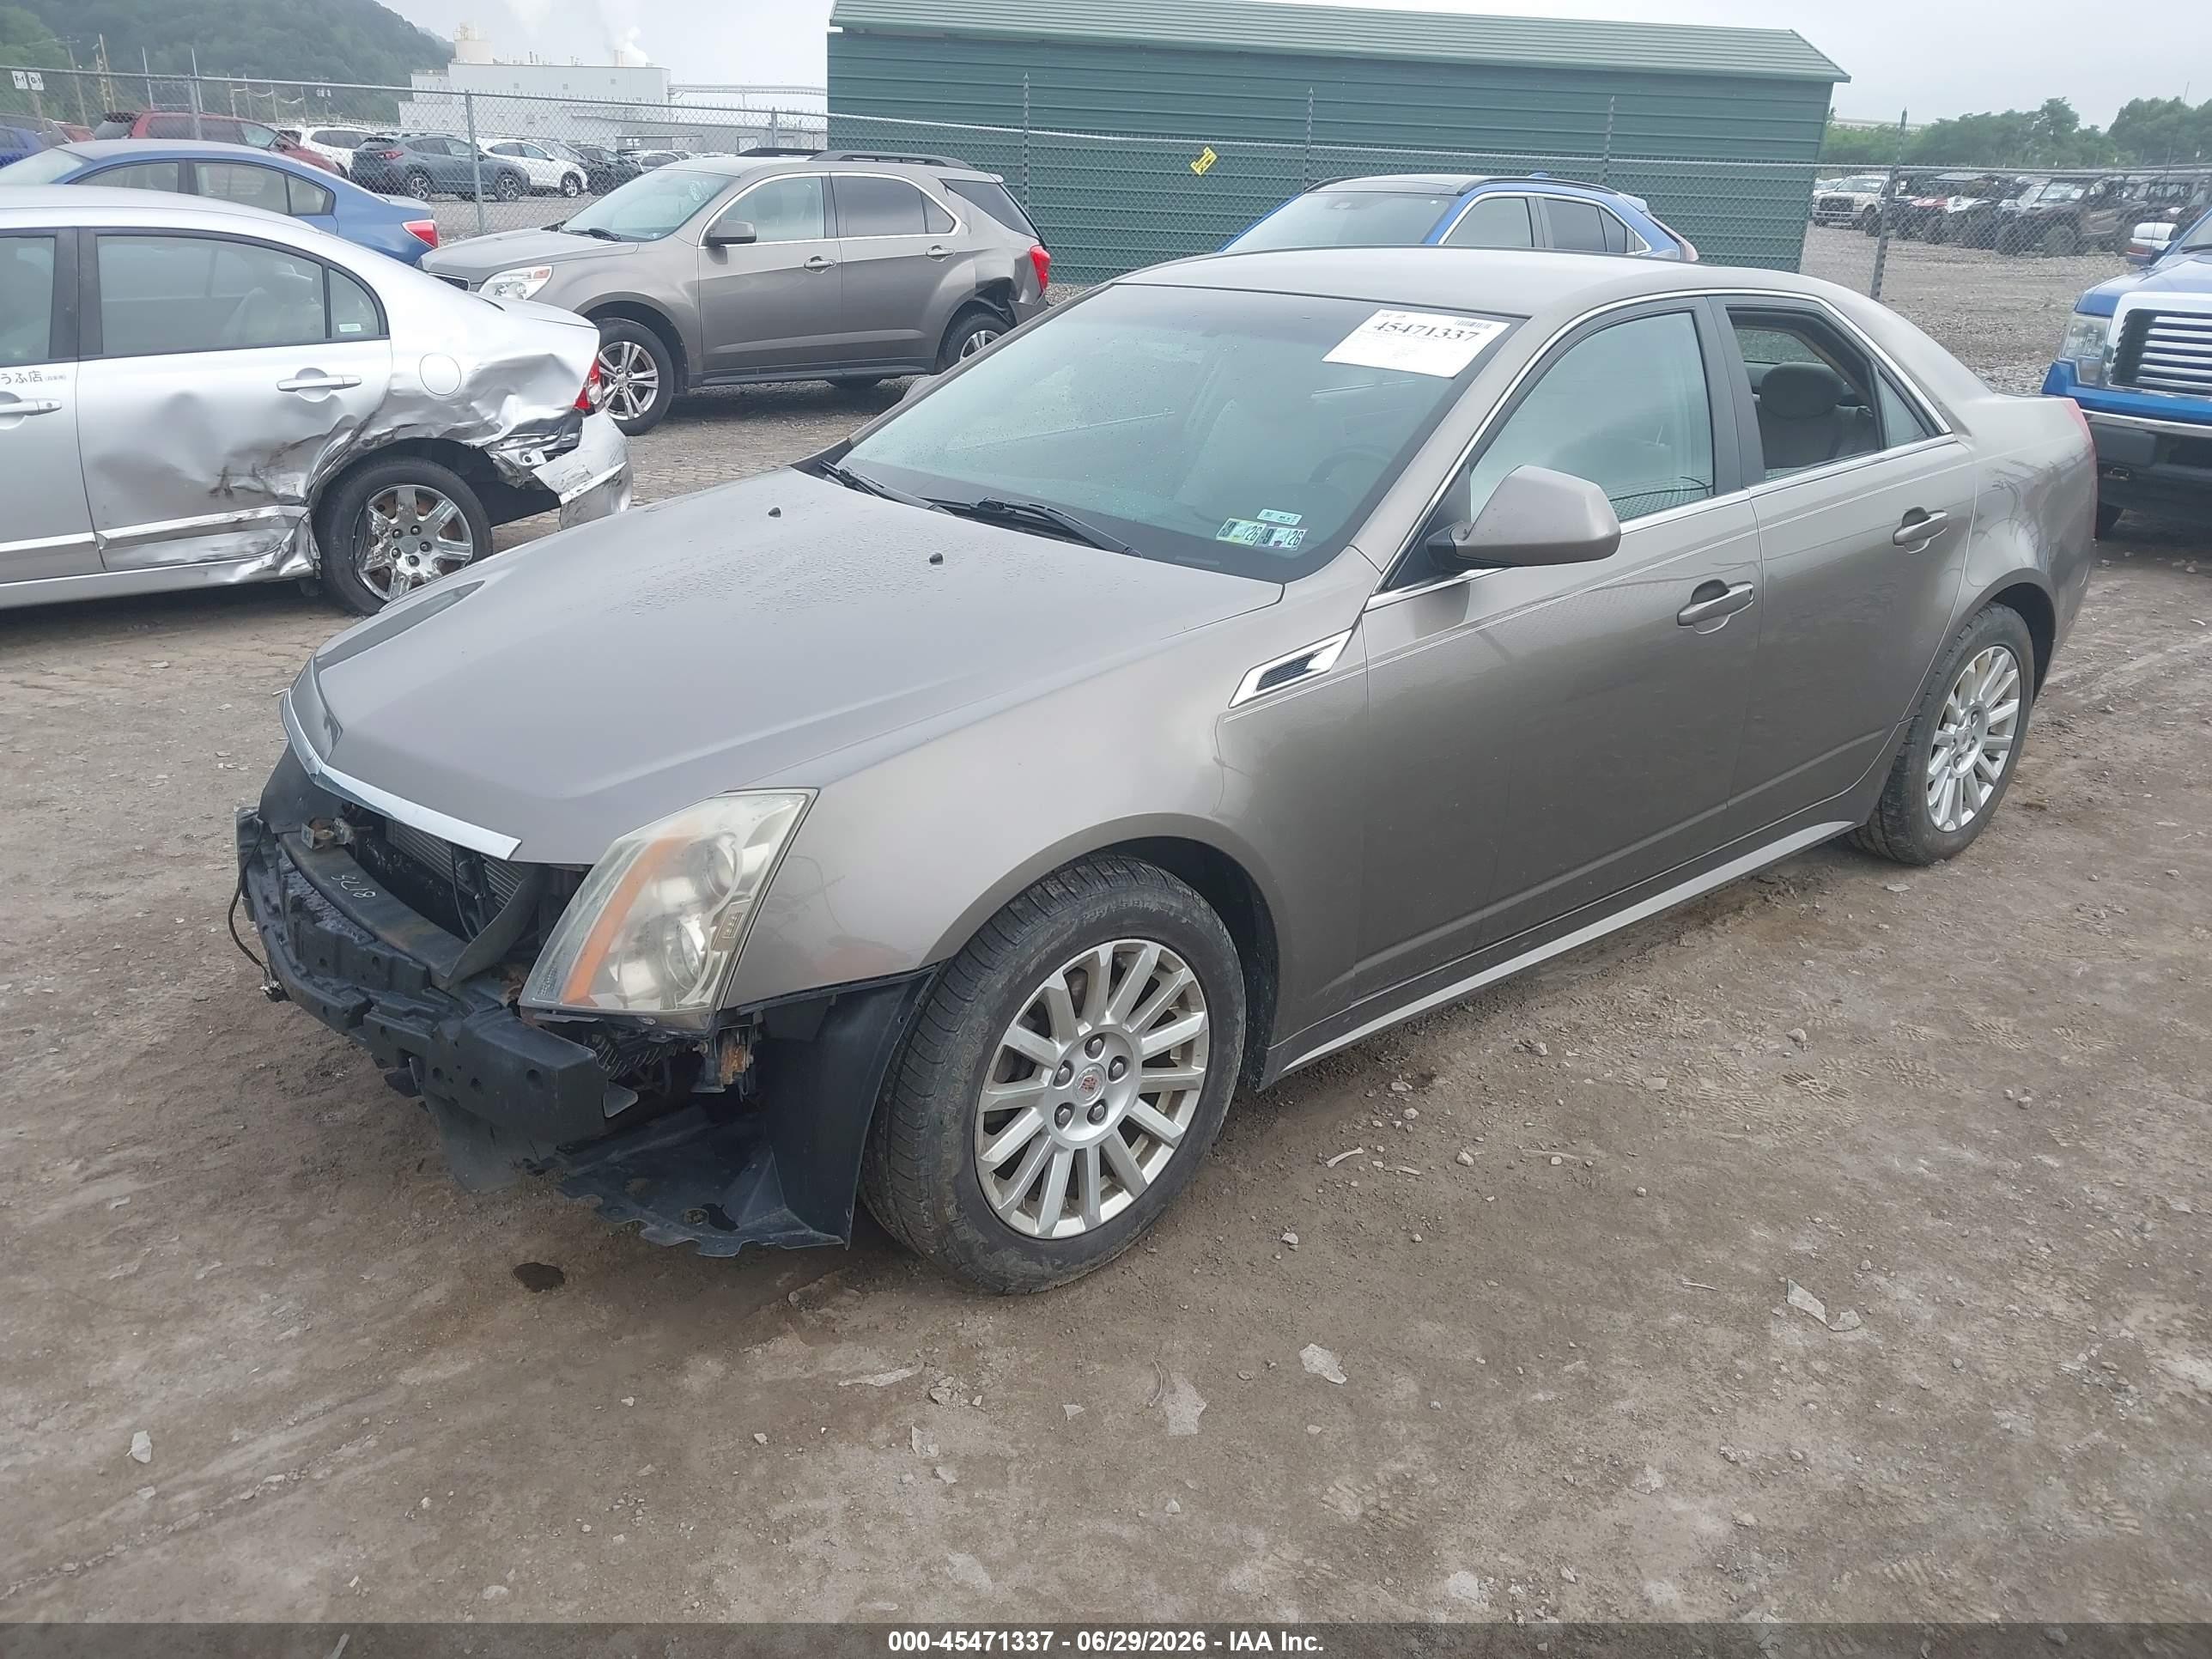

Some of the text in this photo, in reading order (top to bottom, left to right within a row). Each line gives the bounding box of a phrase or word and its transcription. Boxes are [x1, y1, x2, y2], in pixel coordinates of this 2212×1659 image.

[1374, 321, 1480, 341] 45471337
[1, 370, 43, 385] うふ店
[1288, 531, 1303, 545] 26
